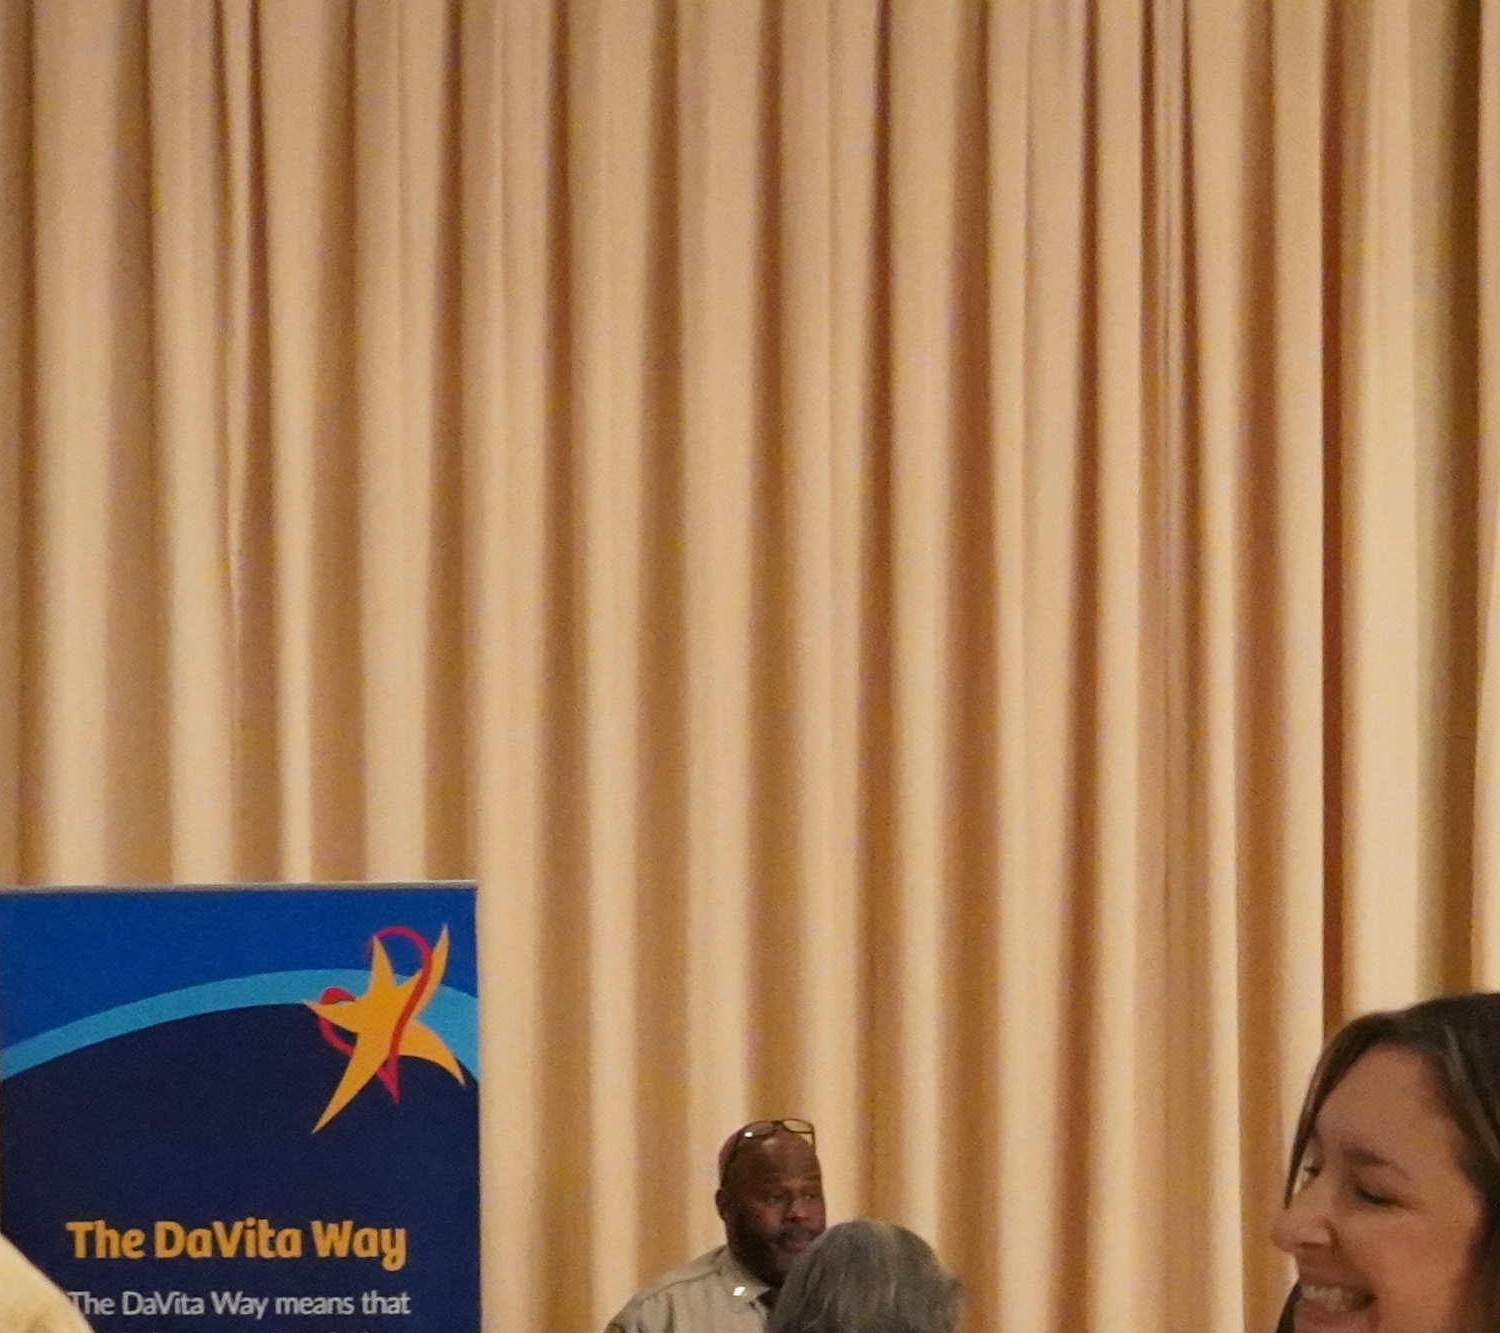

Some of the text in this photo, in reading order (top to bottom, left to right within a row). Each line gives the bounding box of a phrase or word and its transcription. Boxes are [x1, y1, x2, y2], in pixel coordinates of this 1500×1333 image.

[65, 1217, 407, 1272] The DaVita Way
[68, 1290, 411, 1320] The DaVita Way means that
